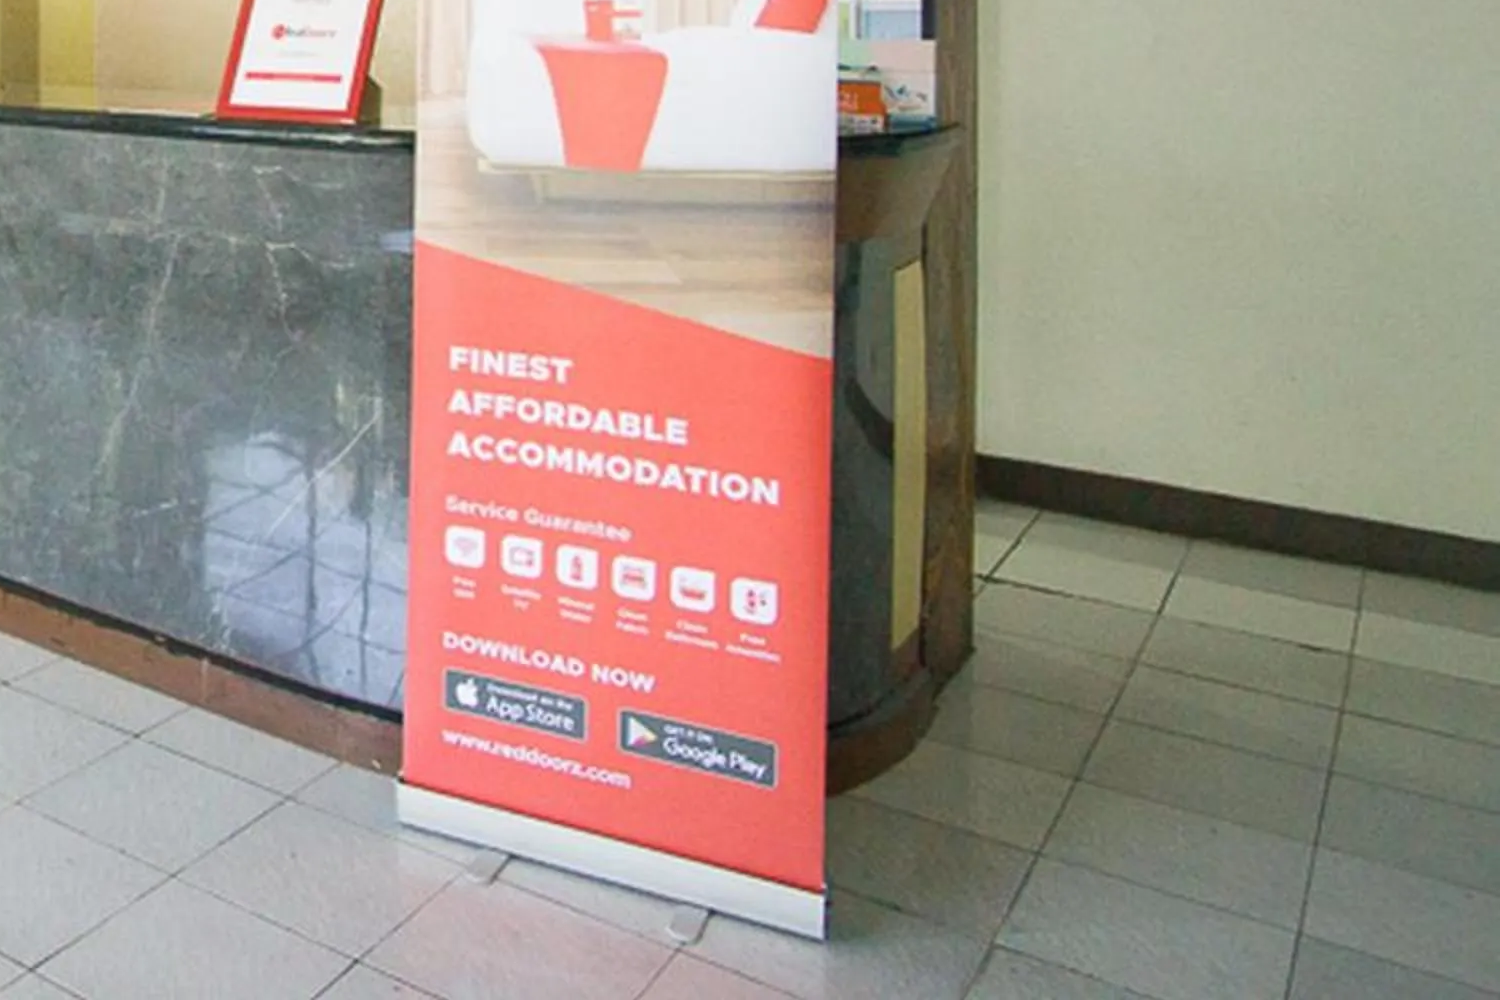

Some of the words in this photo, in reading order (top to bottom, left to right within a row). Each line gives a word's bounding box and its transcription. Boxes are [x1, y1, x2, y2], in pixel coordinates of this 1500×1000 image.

[449, 345, 573, 385] FINEST
[447, 389, 688, 445] AFFORDABLE
[446, 432, 780, 506] ACCOMMODATION
[445, 494, 519, 522] Service
[523, 506, 633, 542] Guarantee
[443, 631, 586, 678] DOWNLOAD
[591, 663, 657, 694] NOW
[485, 695, 525, 722] App
[525, 703, 575, 731] Store
[442, 730, 632, 789] www.reddoorz.com
[663, 736, 726, 768] Google
[729, 750, 767, 780] Play
